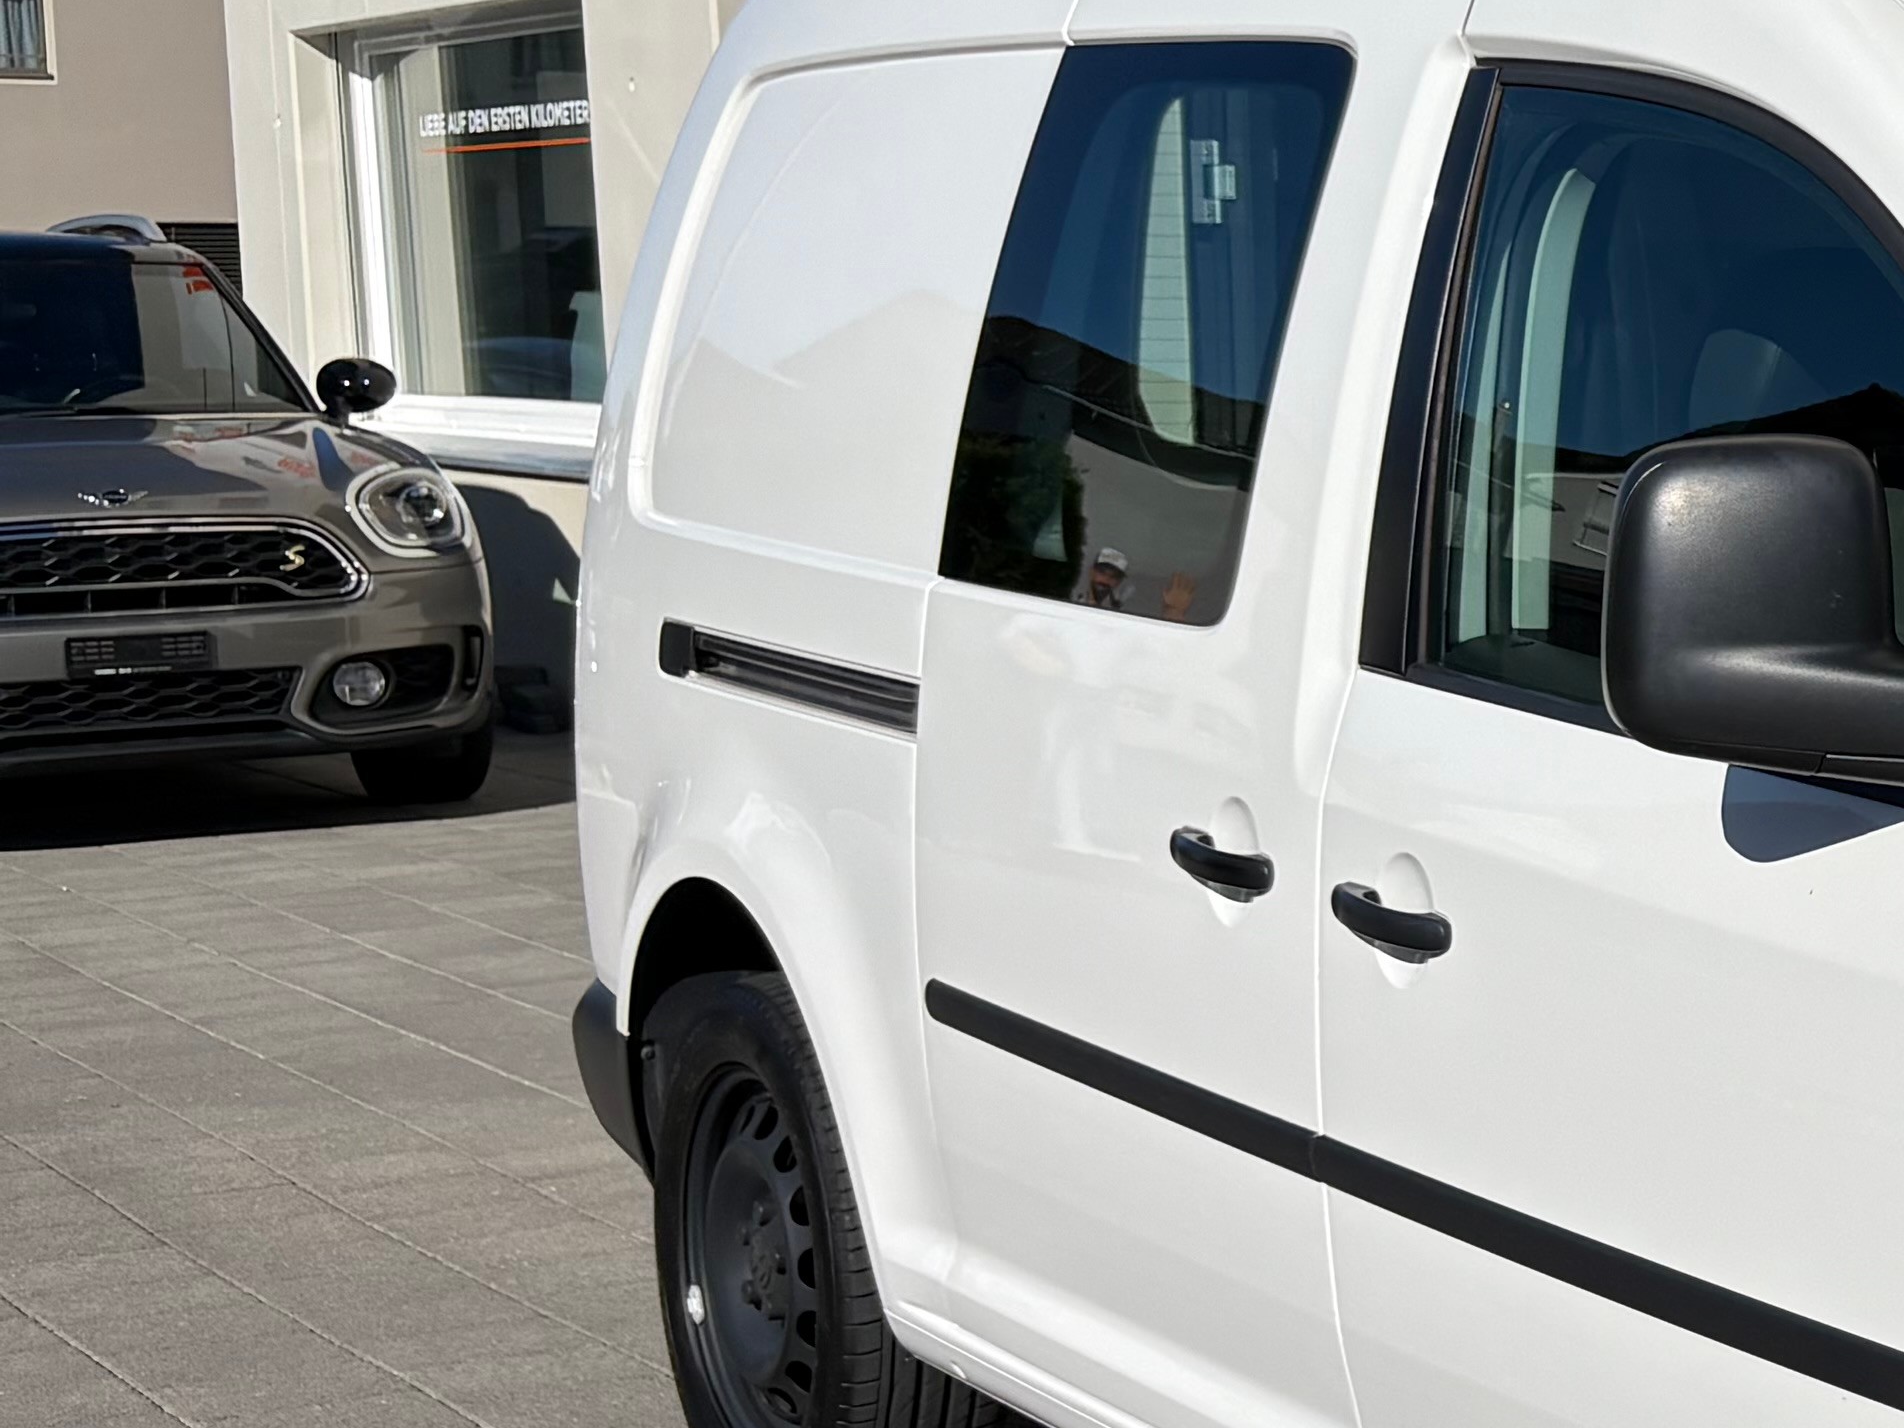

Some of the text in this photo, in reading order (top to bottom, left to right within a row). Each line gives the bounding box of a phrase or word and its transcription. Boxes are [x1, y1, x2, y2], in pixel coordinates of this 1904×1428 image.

[419, 99, 591, 138] LIEBE AUF DEN ERSTEN KILOMETER
